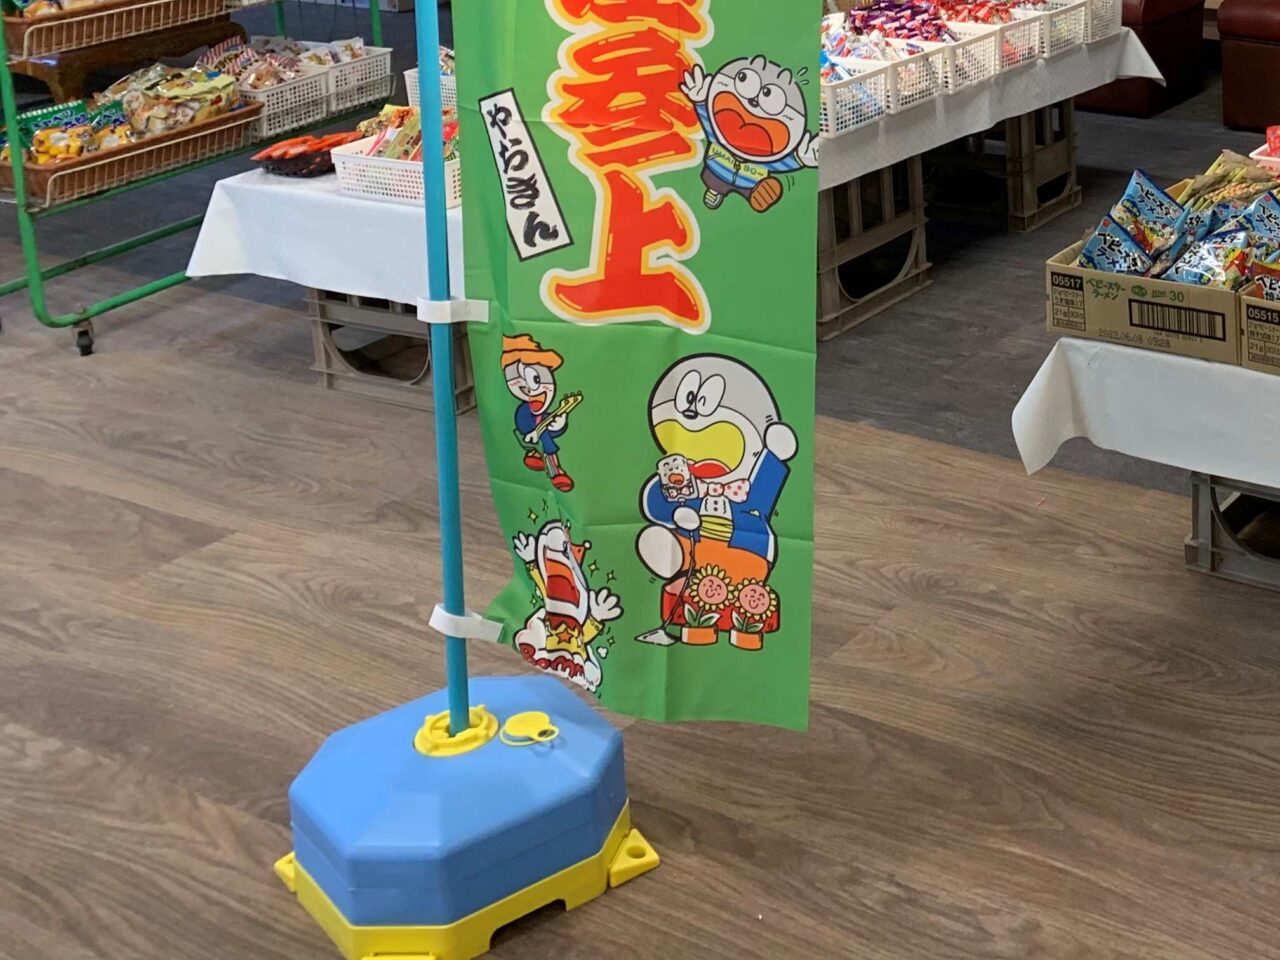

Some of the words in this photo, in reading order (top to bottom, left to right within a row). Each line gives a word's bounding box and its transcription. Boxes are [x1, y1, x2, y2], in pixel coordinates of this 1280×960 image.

[486, 103, 559, 248] やおきん
[1052, 272, 1081, 288] 05517
[1086, 278, 1126, 292] ベビースター
[1169, 290, 1184, 303] 30
[1092, 289, 1119, 301] ラーメン
[1247, 307, 1280, 324] 05515
